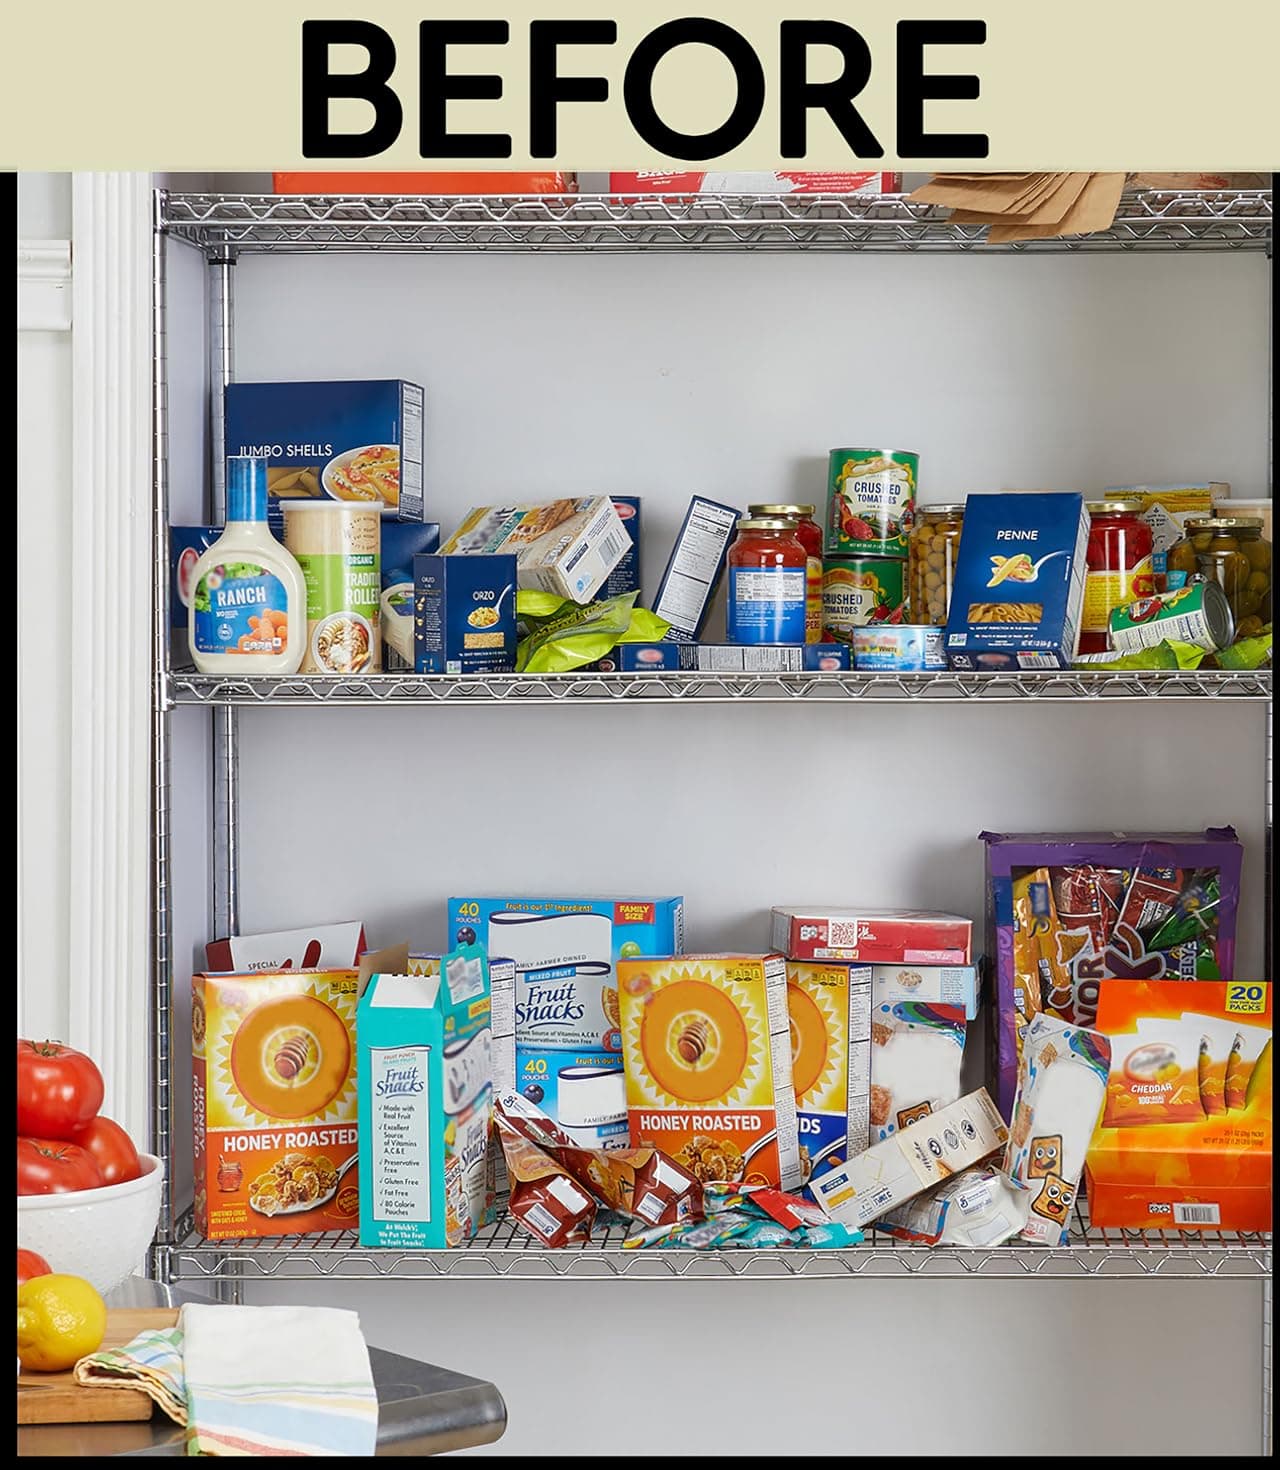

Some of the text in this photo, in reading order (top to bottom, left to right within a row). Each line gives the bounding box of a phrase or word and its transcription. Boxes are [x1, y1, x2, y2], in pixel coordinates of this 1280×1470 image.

[240, 444, 332, 457] JUMBO SHELLS
[854, 482, 900, 495] CRUSED
[858, 495, 896, 504] TOMATES
[997, 530, 1039, 540] PENNE
[217, 586, 267, 607] RANCH
[472, 591, 495, 601] ORZO
[459, 903, 479, 917] 40
[620, 905, 649, 913] FAMILY
[248, 961, 278, 971] SPECIAL
[552, 970, 572, 978] FRUIT
[527, 983, 576, 1007] Fruit
[1230, 986, 1263, 1000] 20
[515, 1001, 584, 1025] Snacks
[525, 1059, 547, 1073] 40
[386, 1067, 418, 1083] Fruit
[376, 1080, 424, 1097] Snacks
[1131, 1083, 1173, 1094] CHEDDAR
[640, 1115, 761, 1131] HONEY ROASTED
[224, 1128, 358, 1152] HONEY ROASTED
